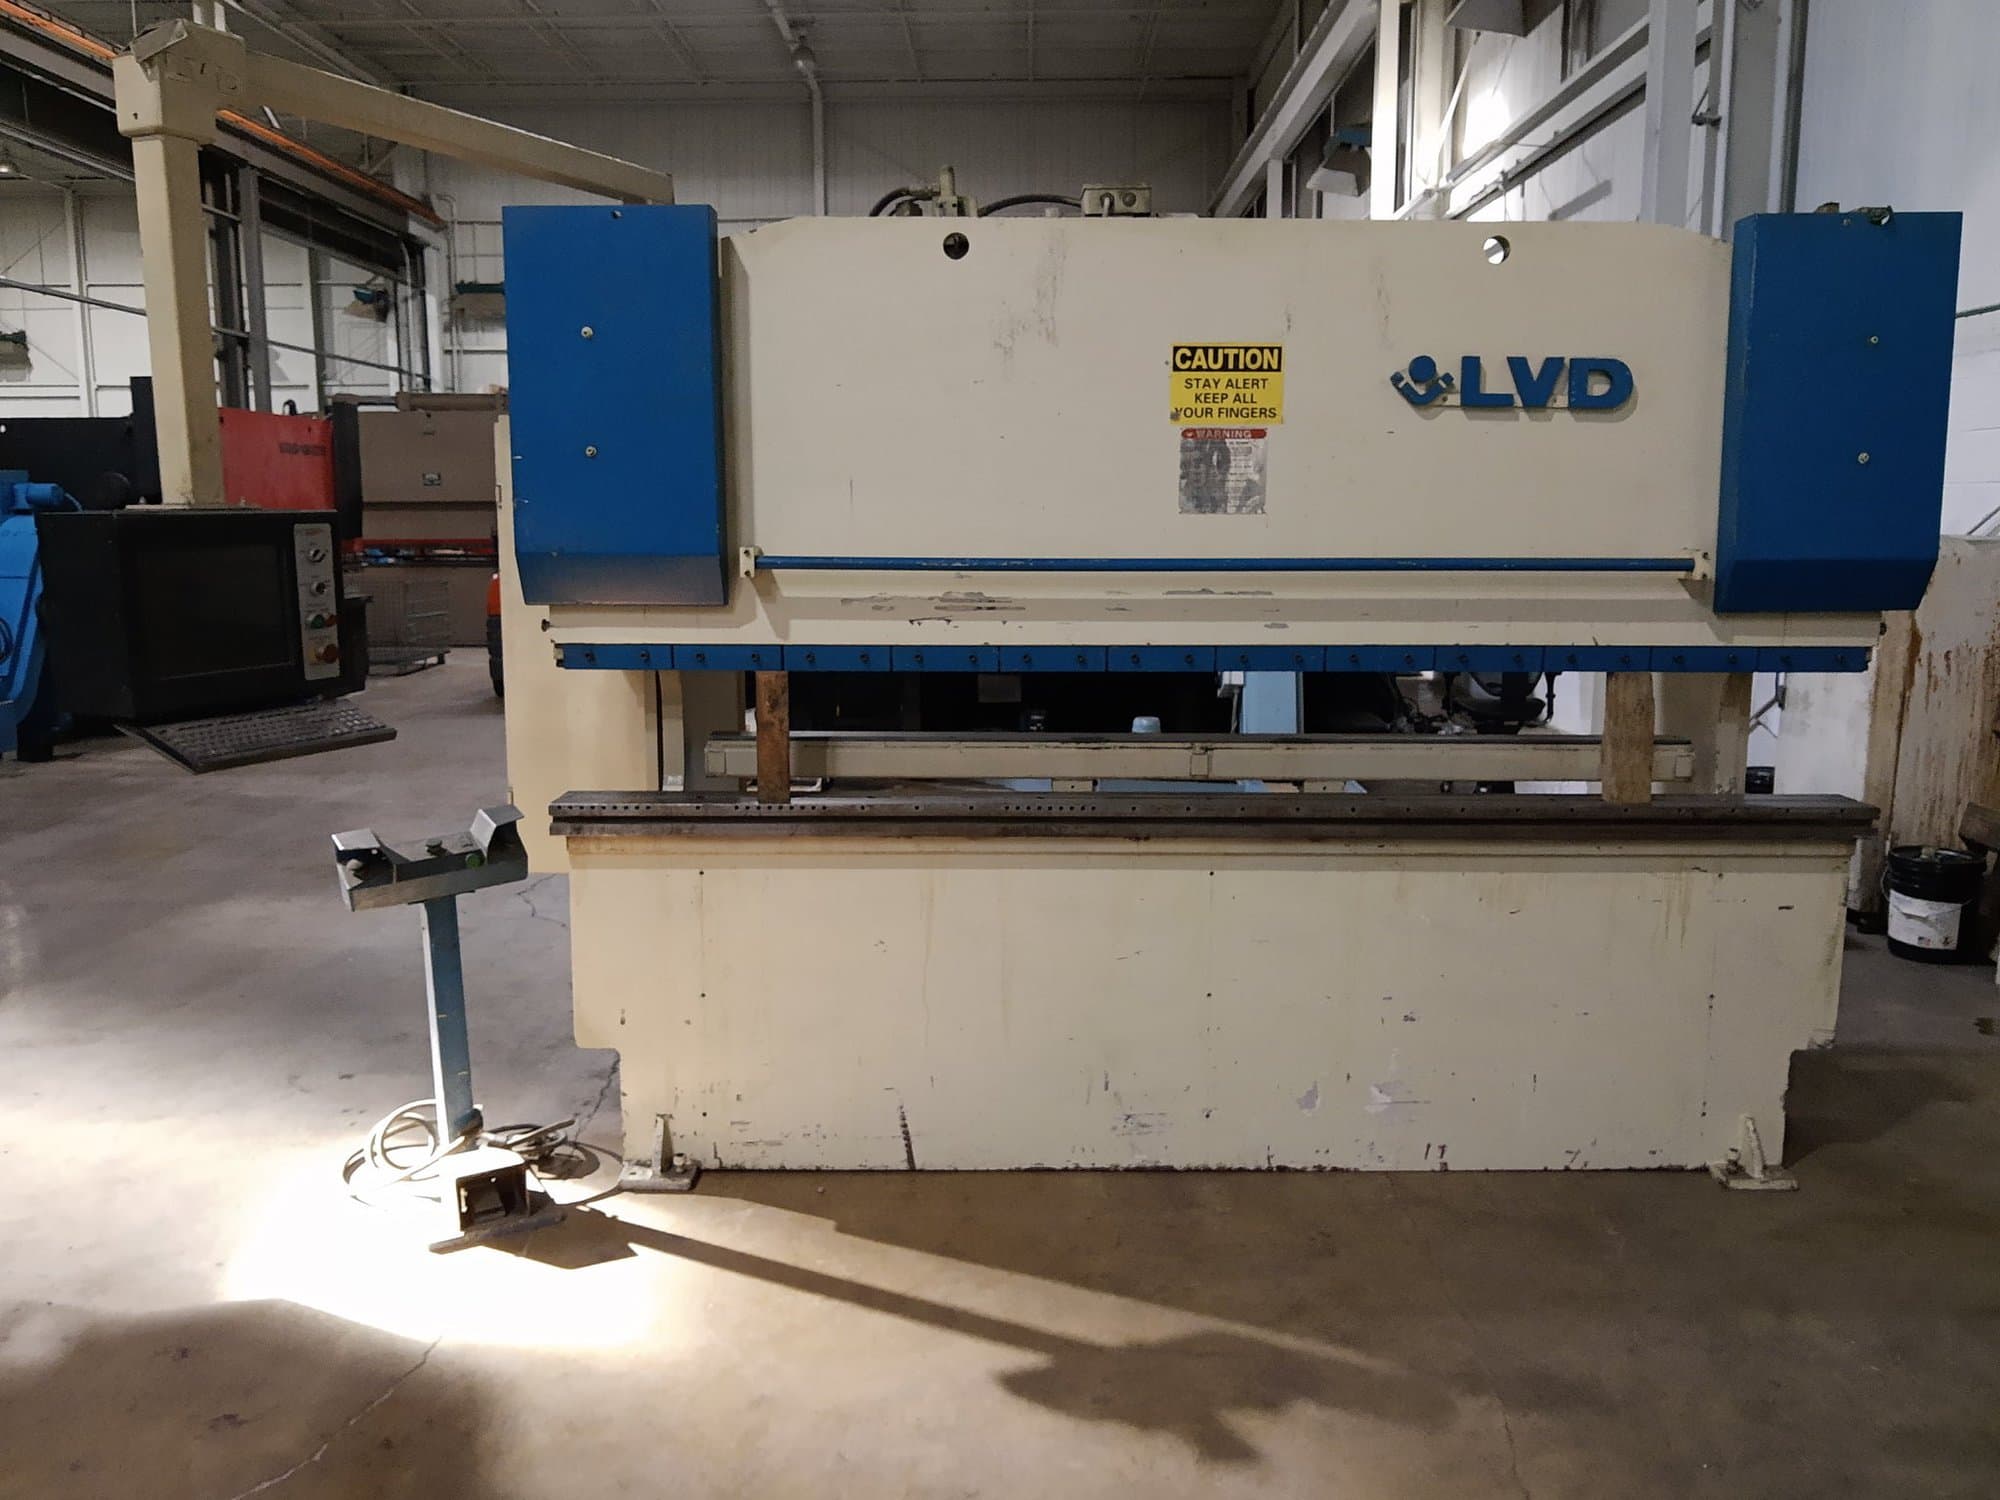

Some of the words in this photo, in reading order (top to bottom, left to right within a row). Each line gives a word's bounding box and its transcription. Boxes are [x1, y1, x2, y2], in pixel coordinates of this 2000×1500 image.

[1175, 348, 1279, 370] CAUTION
[1184, 378, 1221, 389] STAY
[1225, 378, 1269, 389] ALERT
[1460, 355, 1634, 409] LVD
[1194, 393, 1229, 404] KEEP
[1232, 393, 1257, 404] ALL
[1175, 407, 1213, 418] YOUR
[1218, 407, 1277, 418] FINGERS
[1196, 430, 1252, 438] WARNING
